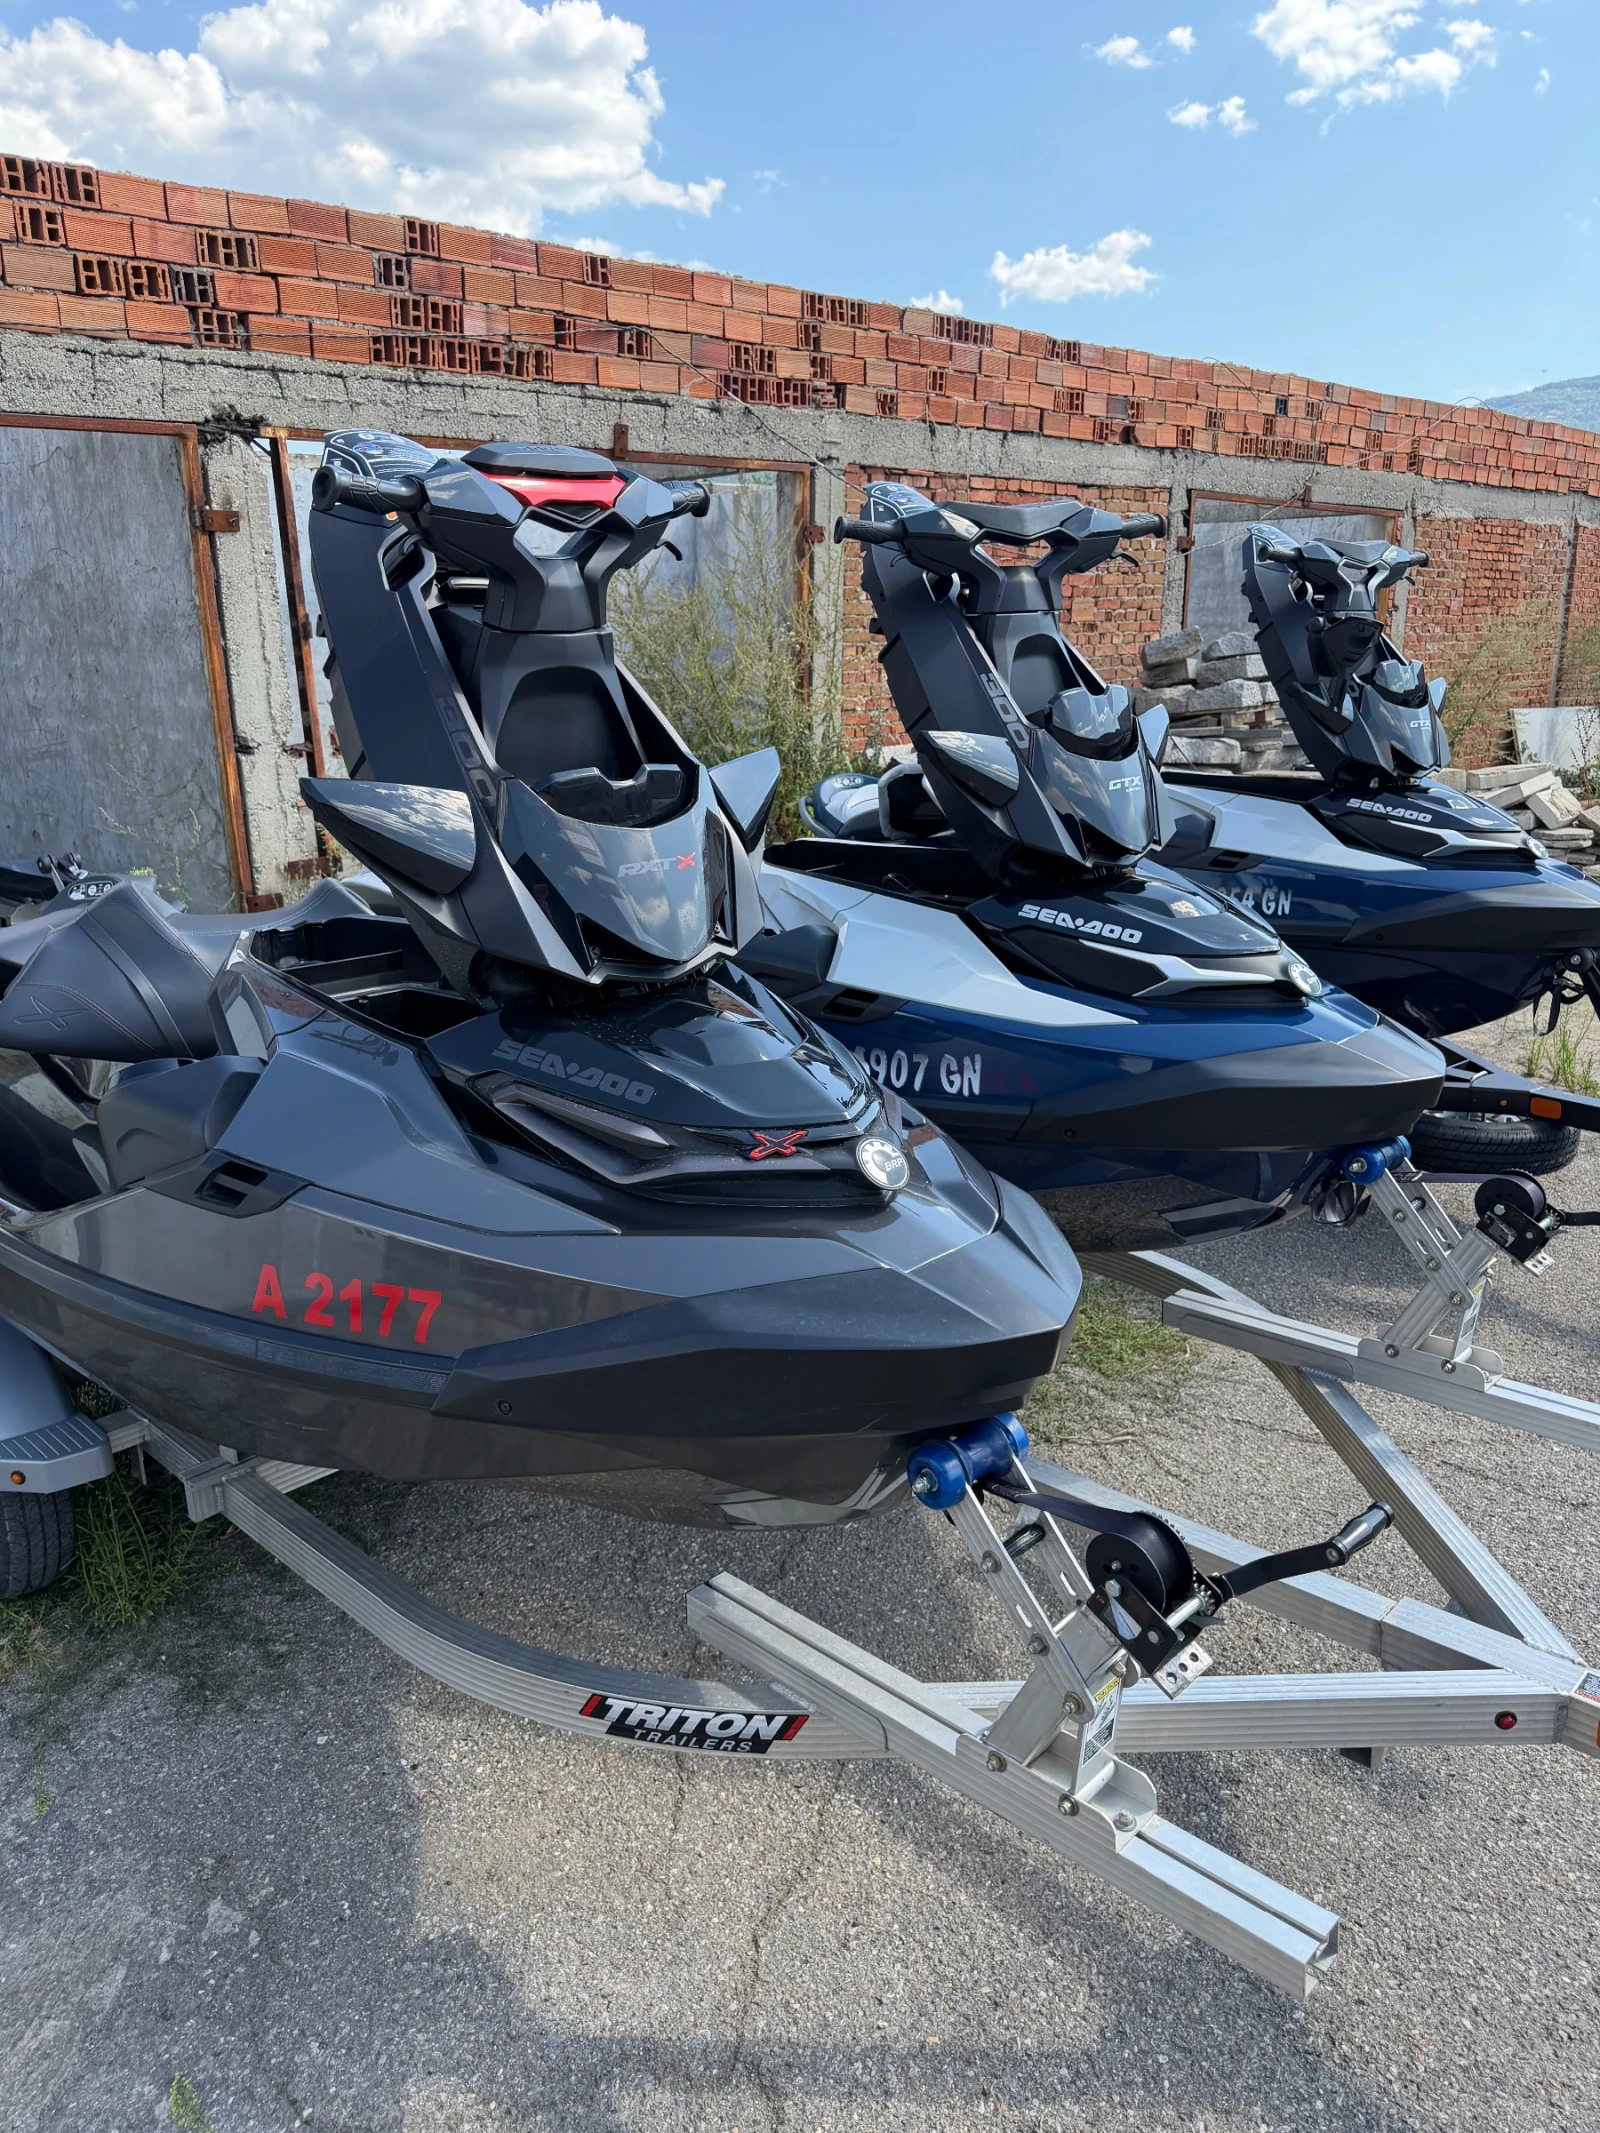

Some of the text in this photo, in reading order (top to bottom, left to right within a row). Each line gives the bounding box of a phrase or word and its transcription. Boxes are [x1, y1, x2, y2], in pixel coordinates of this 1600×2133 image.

[980, 672, 1030, 749] 300
[1410, 719, 1431, 728] GTX
[437, 695, 498, 808] 300
[1108, 775, 1142, 791] GTX
[1261, 887, 1292, 916] GN
[939, 1053, 982, 1098] GN
[884, 1157, 903, 1173] BRP
[252, 1263, 442, 1344] A 2177
[603, 1697, 788, 1741] TRITON
[633, 1728, 753, 1753] TRAILERS
